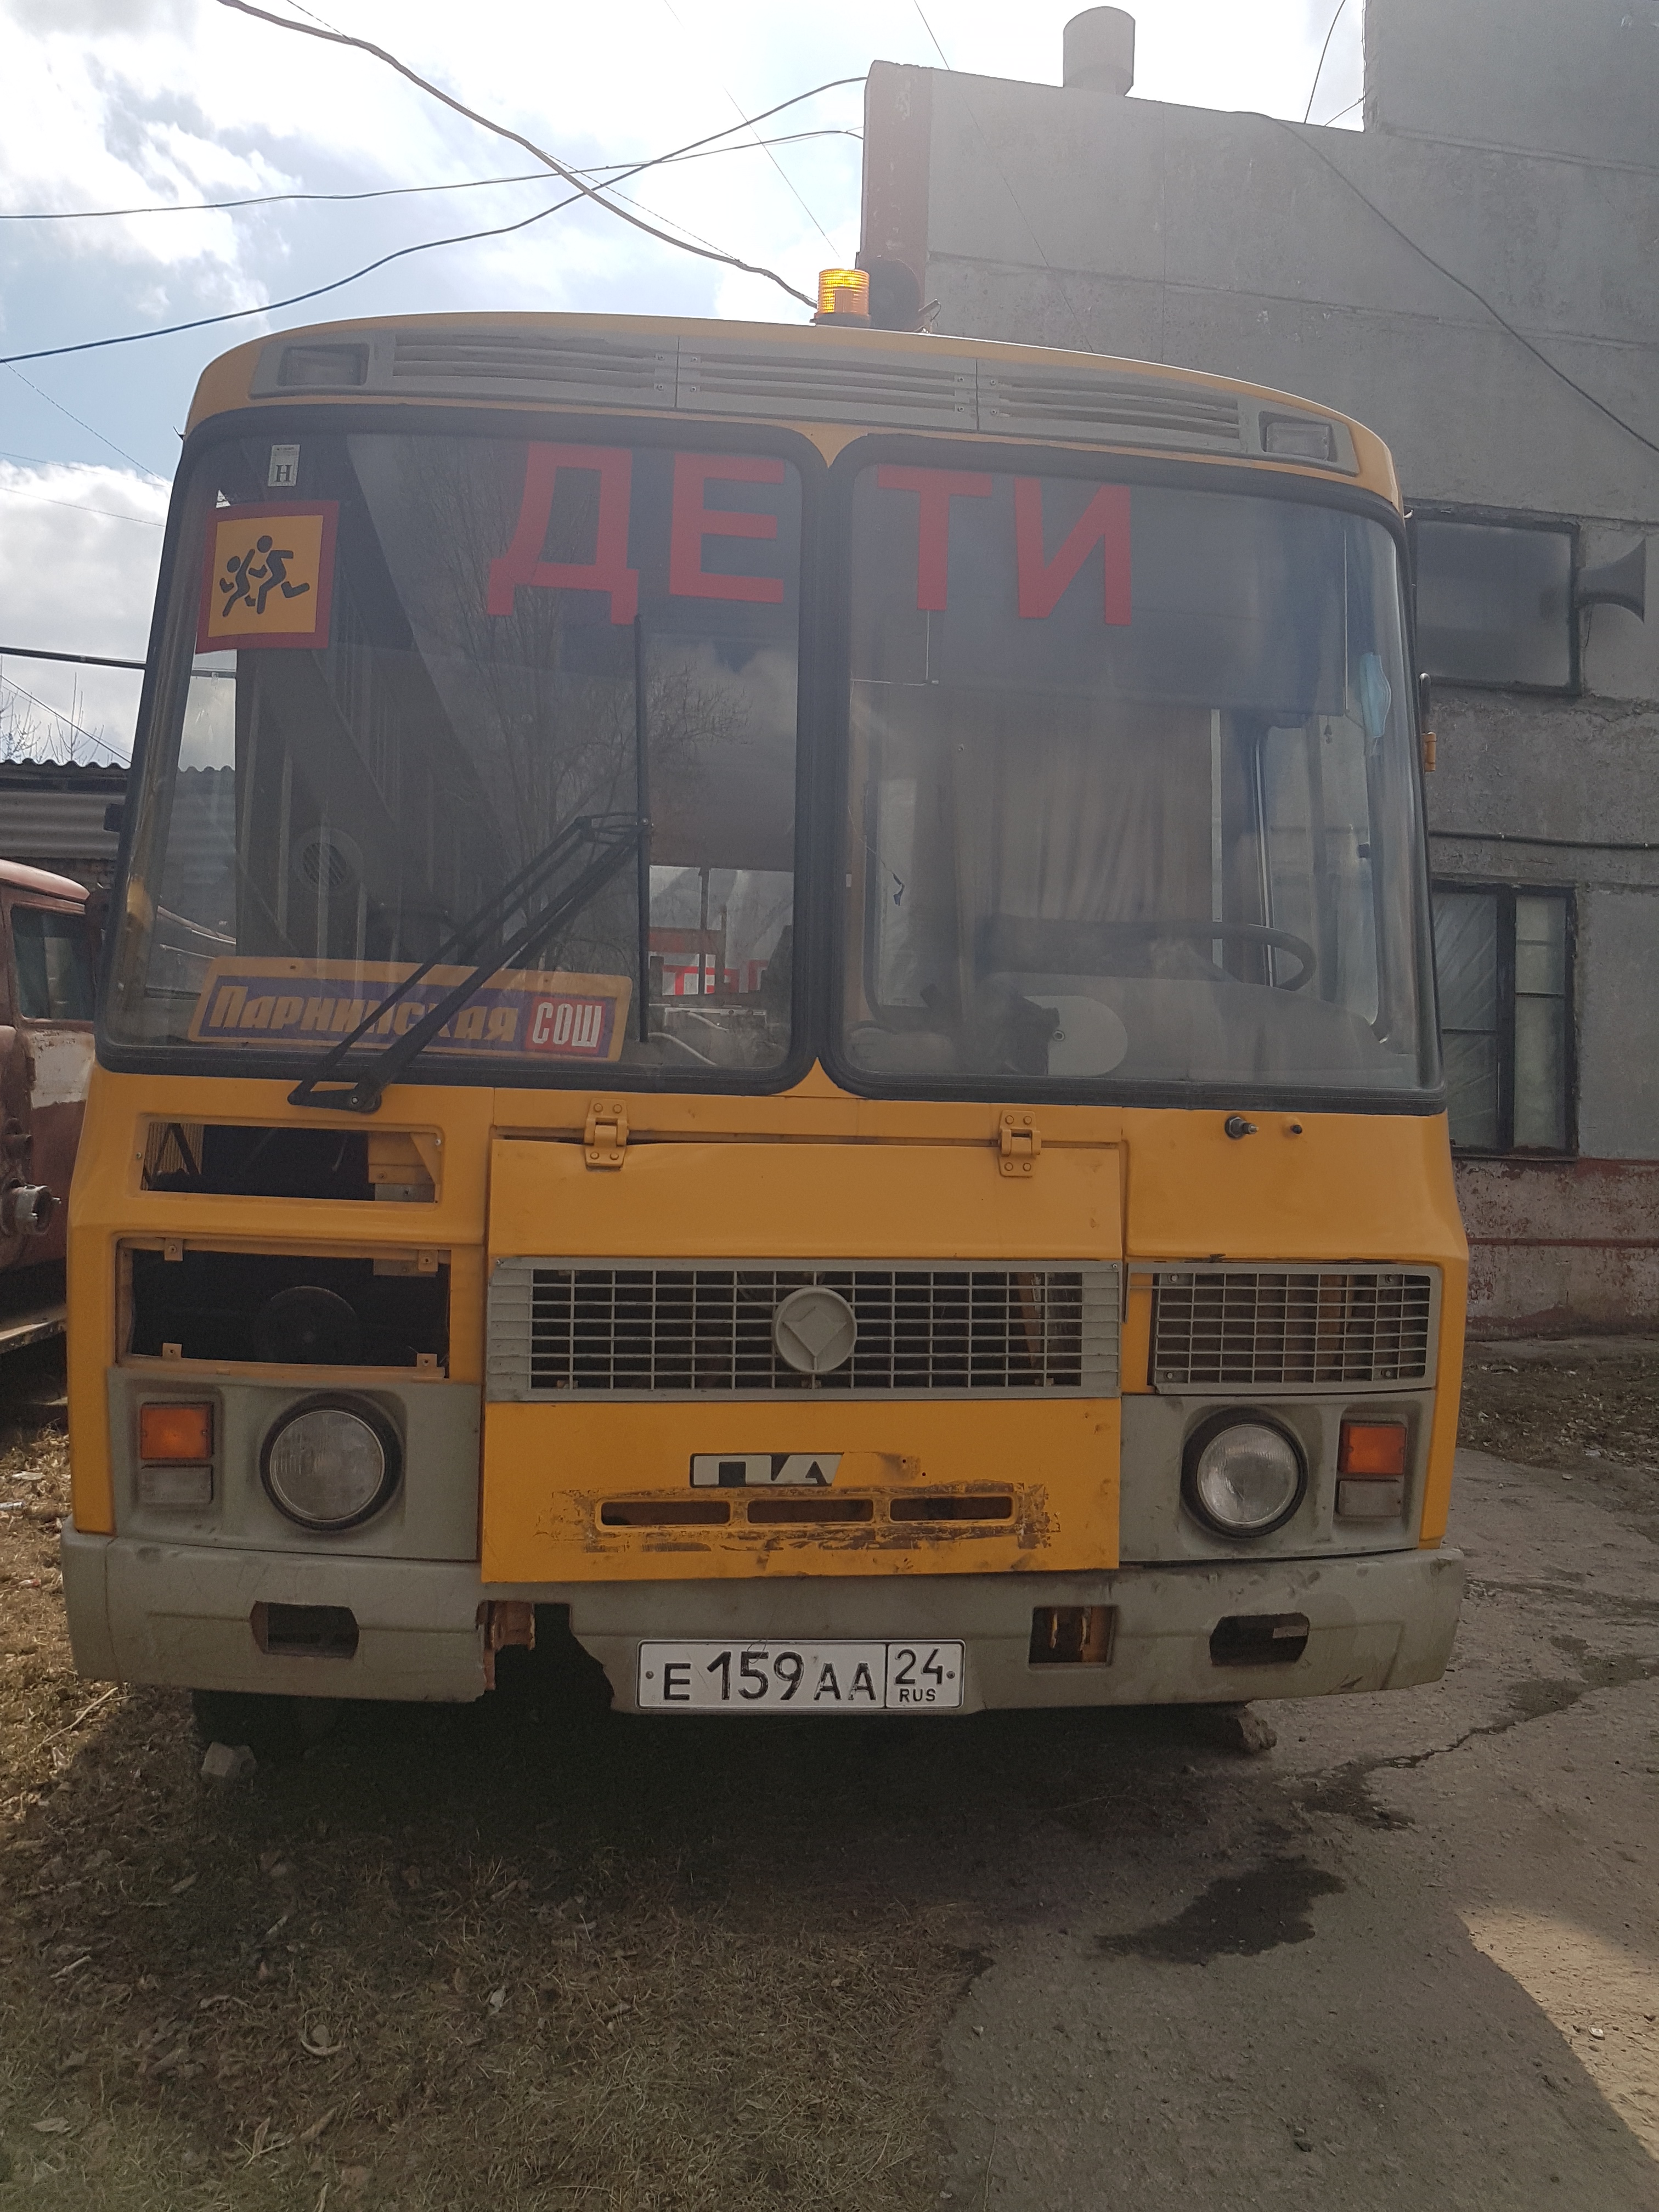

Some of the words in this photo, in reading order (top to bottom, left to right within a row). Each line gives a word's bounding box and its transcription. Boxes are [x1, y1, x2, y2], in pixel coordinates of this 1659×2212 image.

[487, 442, 1132, 625] ДЕТИ
[208, 985, 519, 1042] Парнинсая
[532, 1002, 602, 1048] СОШ
[894, 1649, 943, 1685] 24
[899, 1688, 936, 1702] RUS
